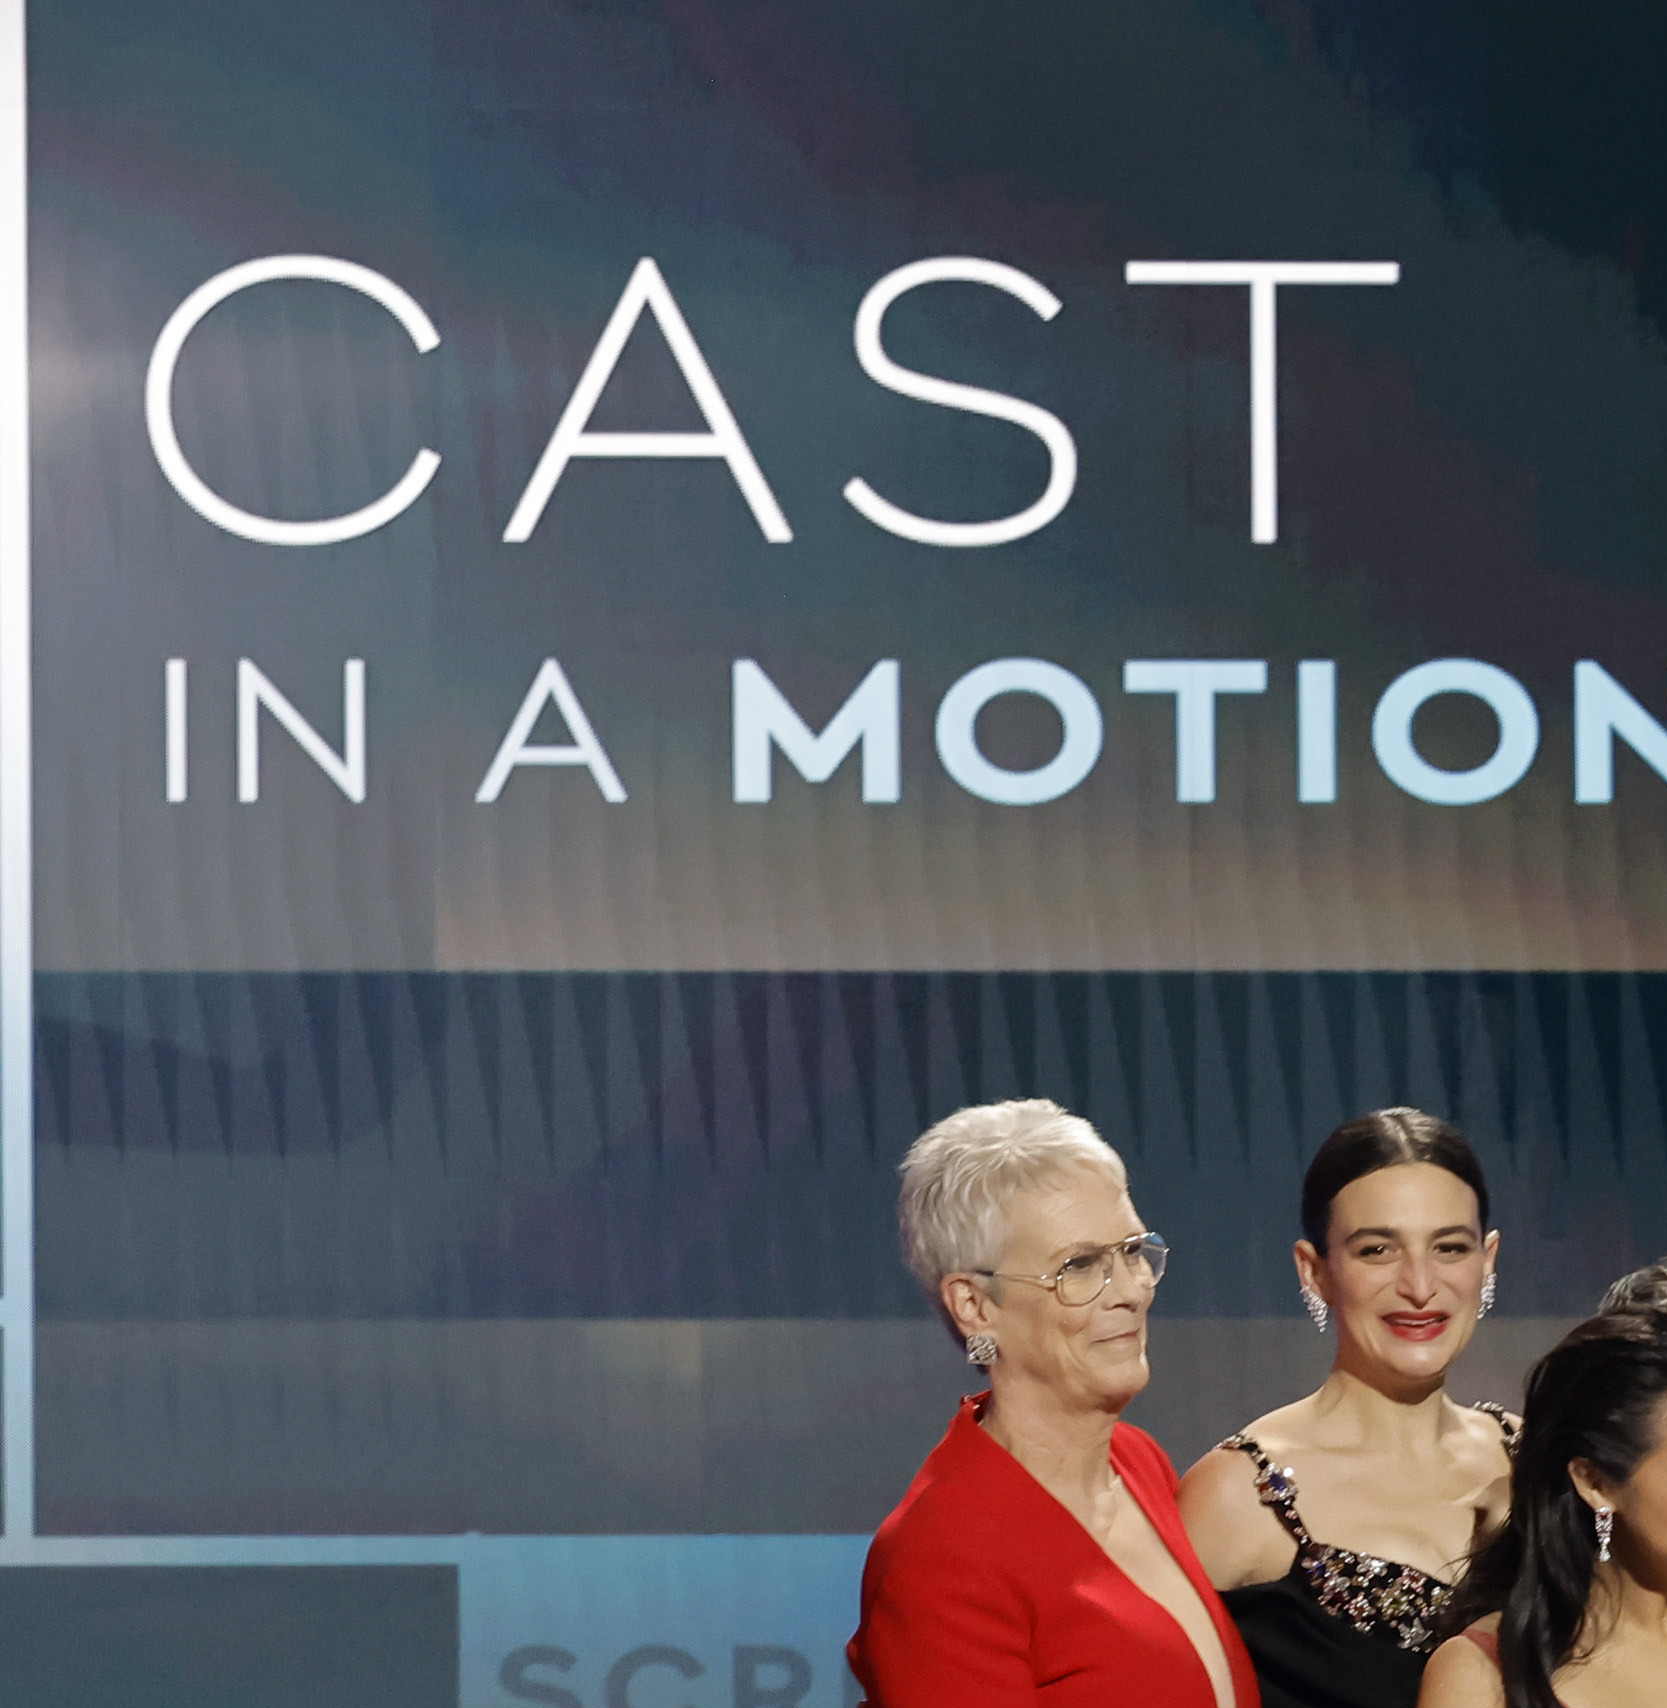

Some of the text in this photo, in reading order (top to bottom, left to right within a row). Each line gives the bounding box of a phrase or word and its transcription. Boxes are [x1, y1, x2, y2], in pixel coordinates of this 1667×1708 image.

[143, 253, 1400, 546] CAST
[164, 656, 367, 804] IN
[473, 656, 629, 804] A
